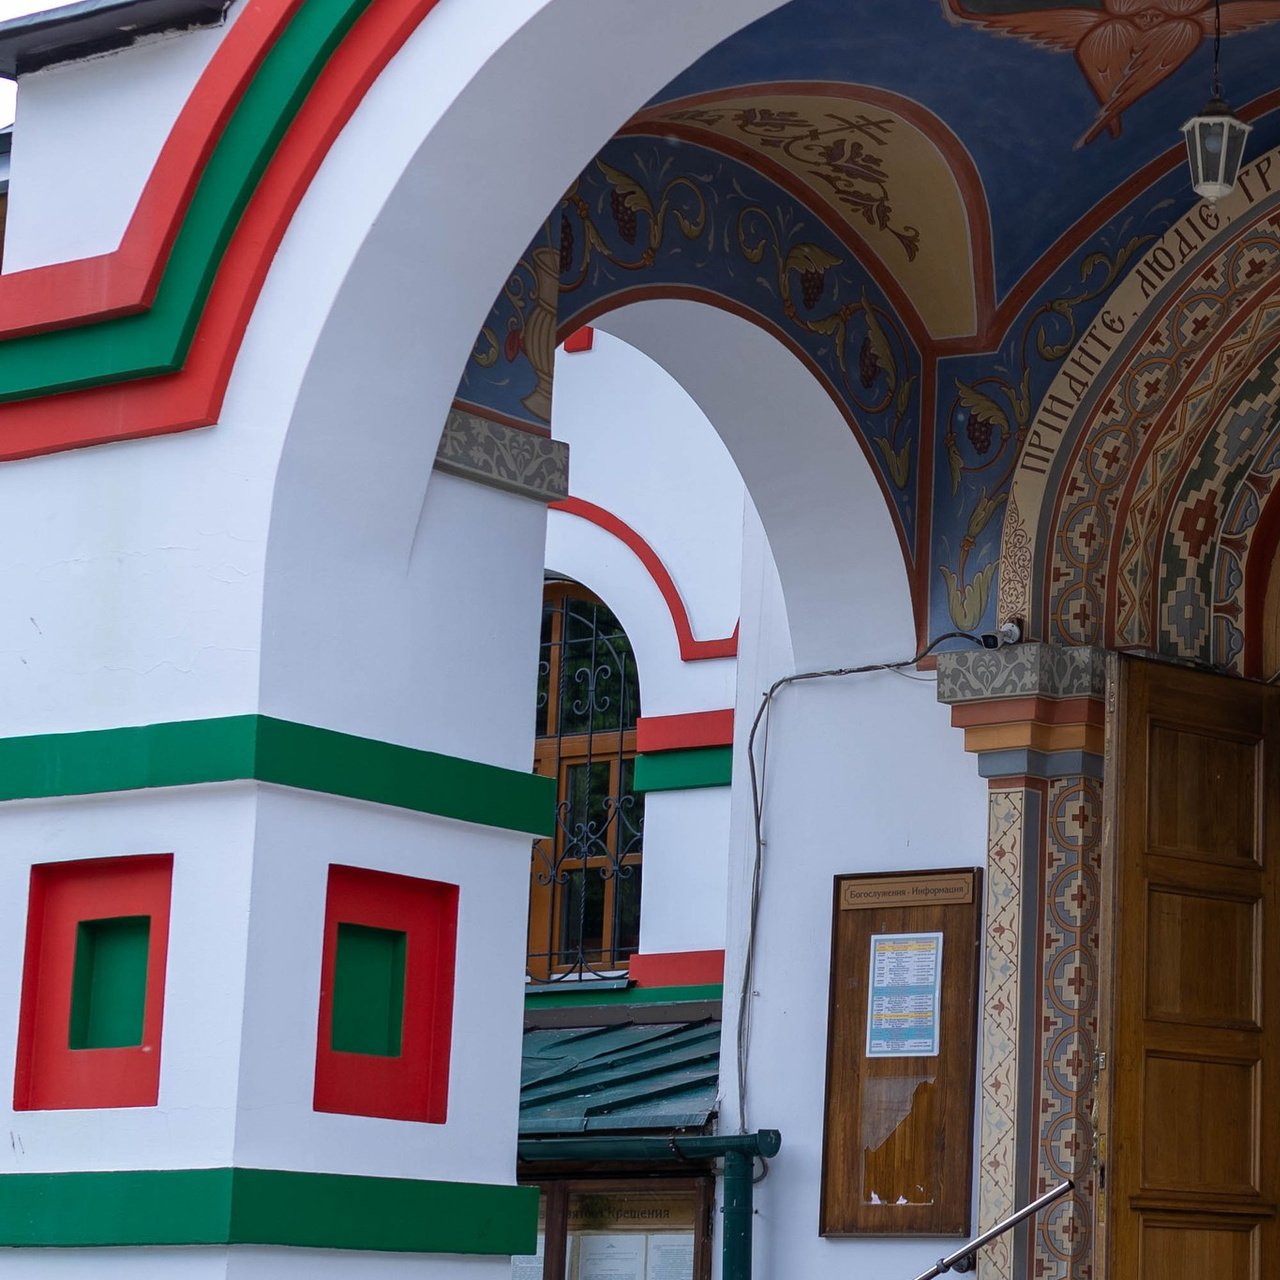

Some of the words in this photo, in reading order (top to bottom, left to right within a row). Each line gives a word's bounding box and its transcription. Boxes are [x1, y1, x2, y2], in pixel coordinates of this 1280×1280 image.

[850, 888, 906, 900] Богослужения
[911, 886, 964, 897] Информация
[608, 1206, 670, 1221] Крещения
